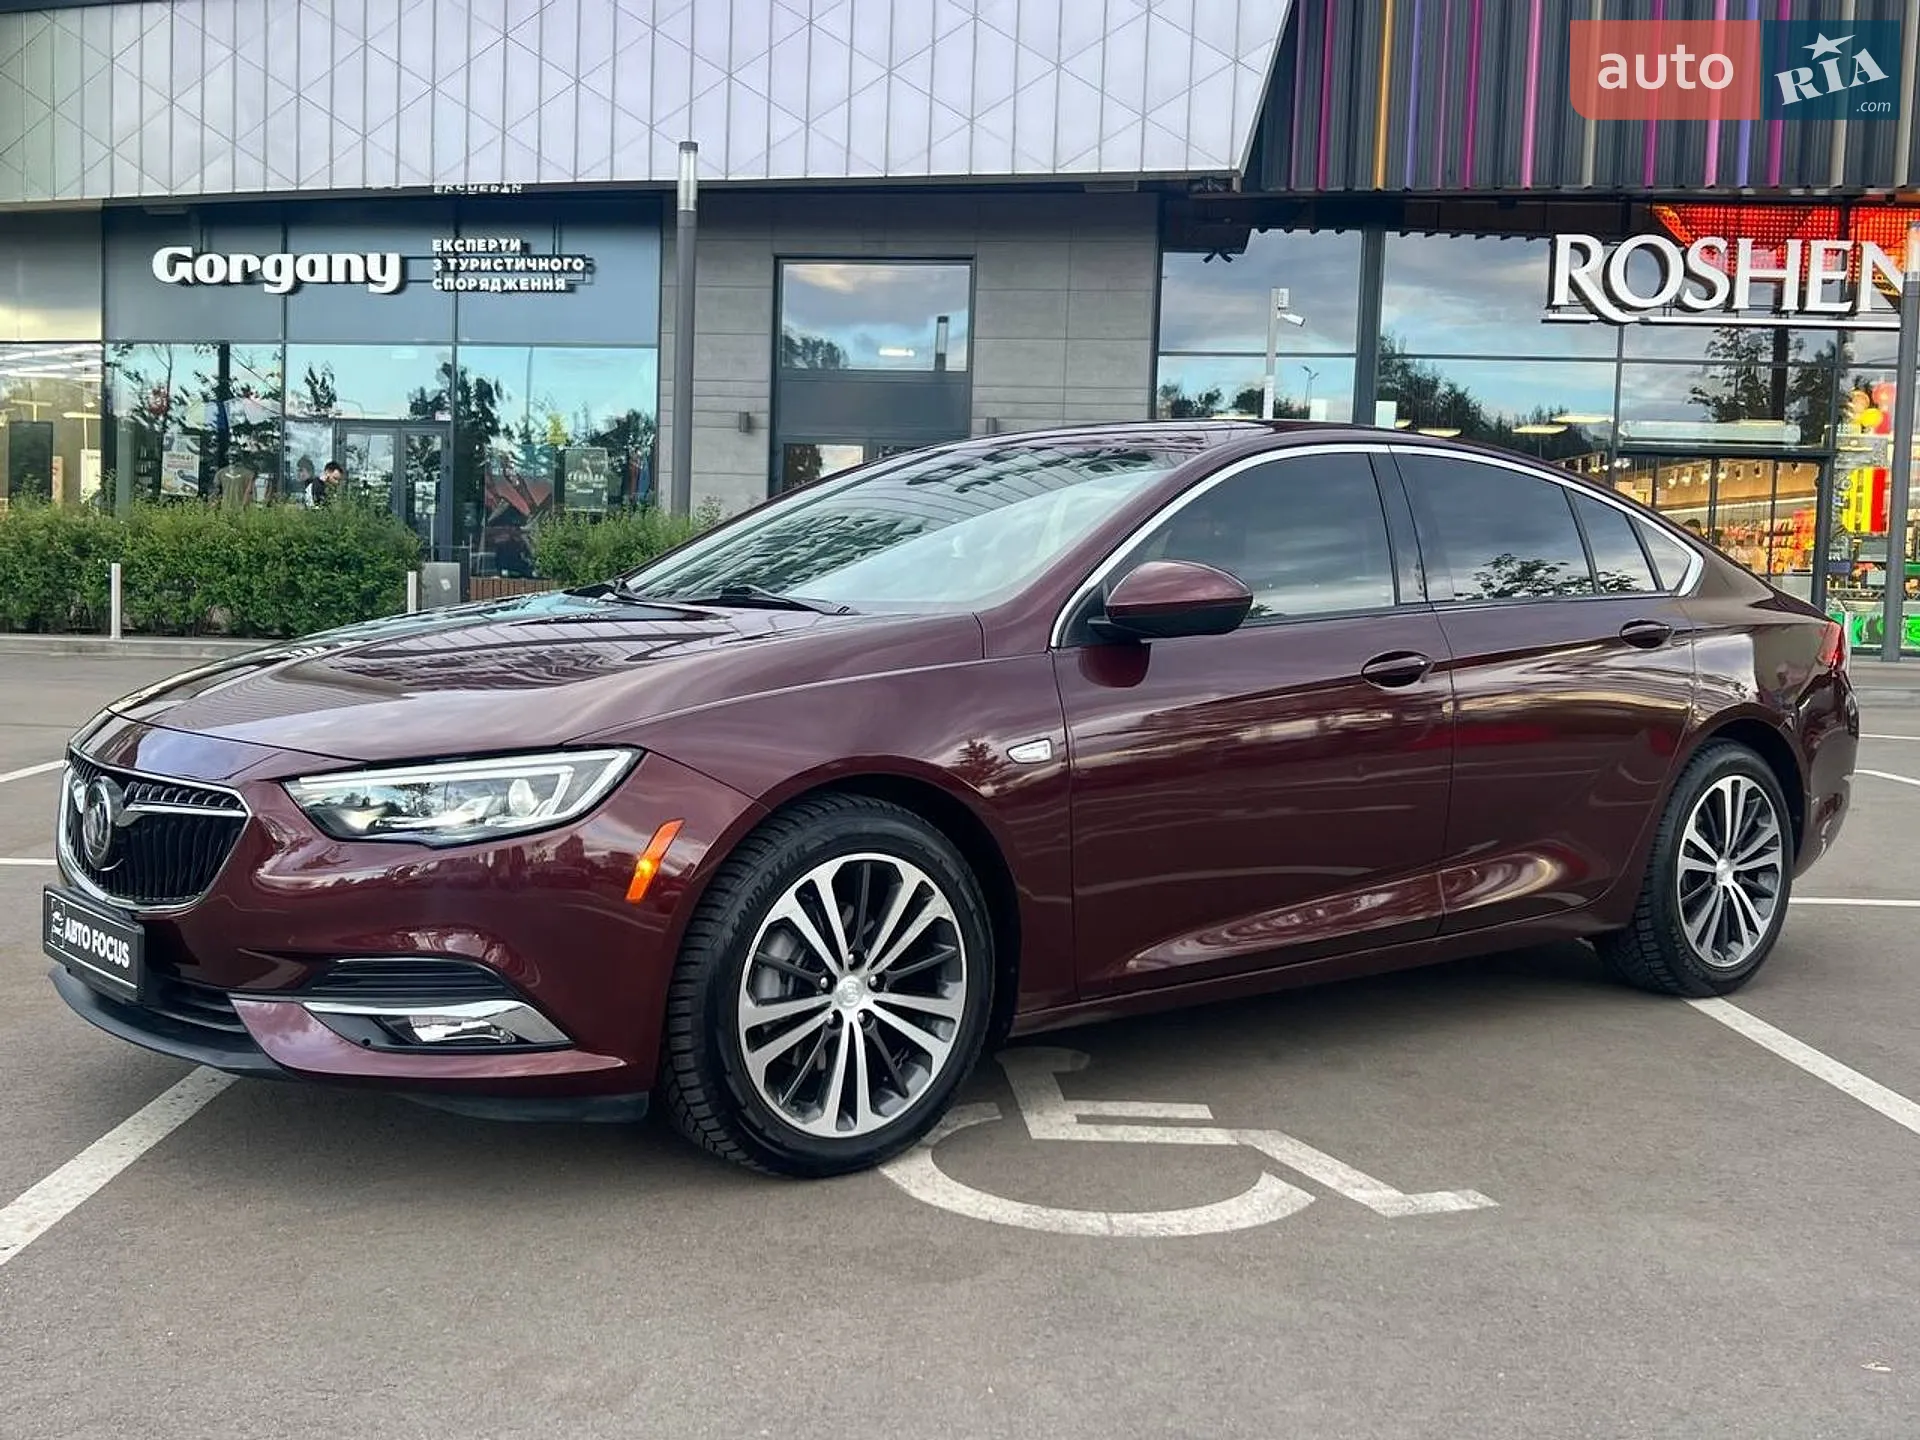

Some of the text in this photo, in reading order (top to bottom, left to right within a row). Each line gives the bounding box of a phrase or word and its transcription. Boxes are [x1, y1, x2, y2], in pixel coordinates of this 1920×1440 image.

[432, 238, 521, 252] ЕКСПЕРТИ
[152, 246, 401, 294] Gorgany
[448, 258, 586, 271] ТУРИСТИЧНОГО
[432, 278, 567, 292] СПОРЯДЖЕННЯ
[1549, 233, 1904, 324] ROSHEN
[92, 928, 130, 969] FOCUS
